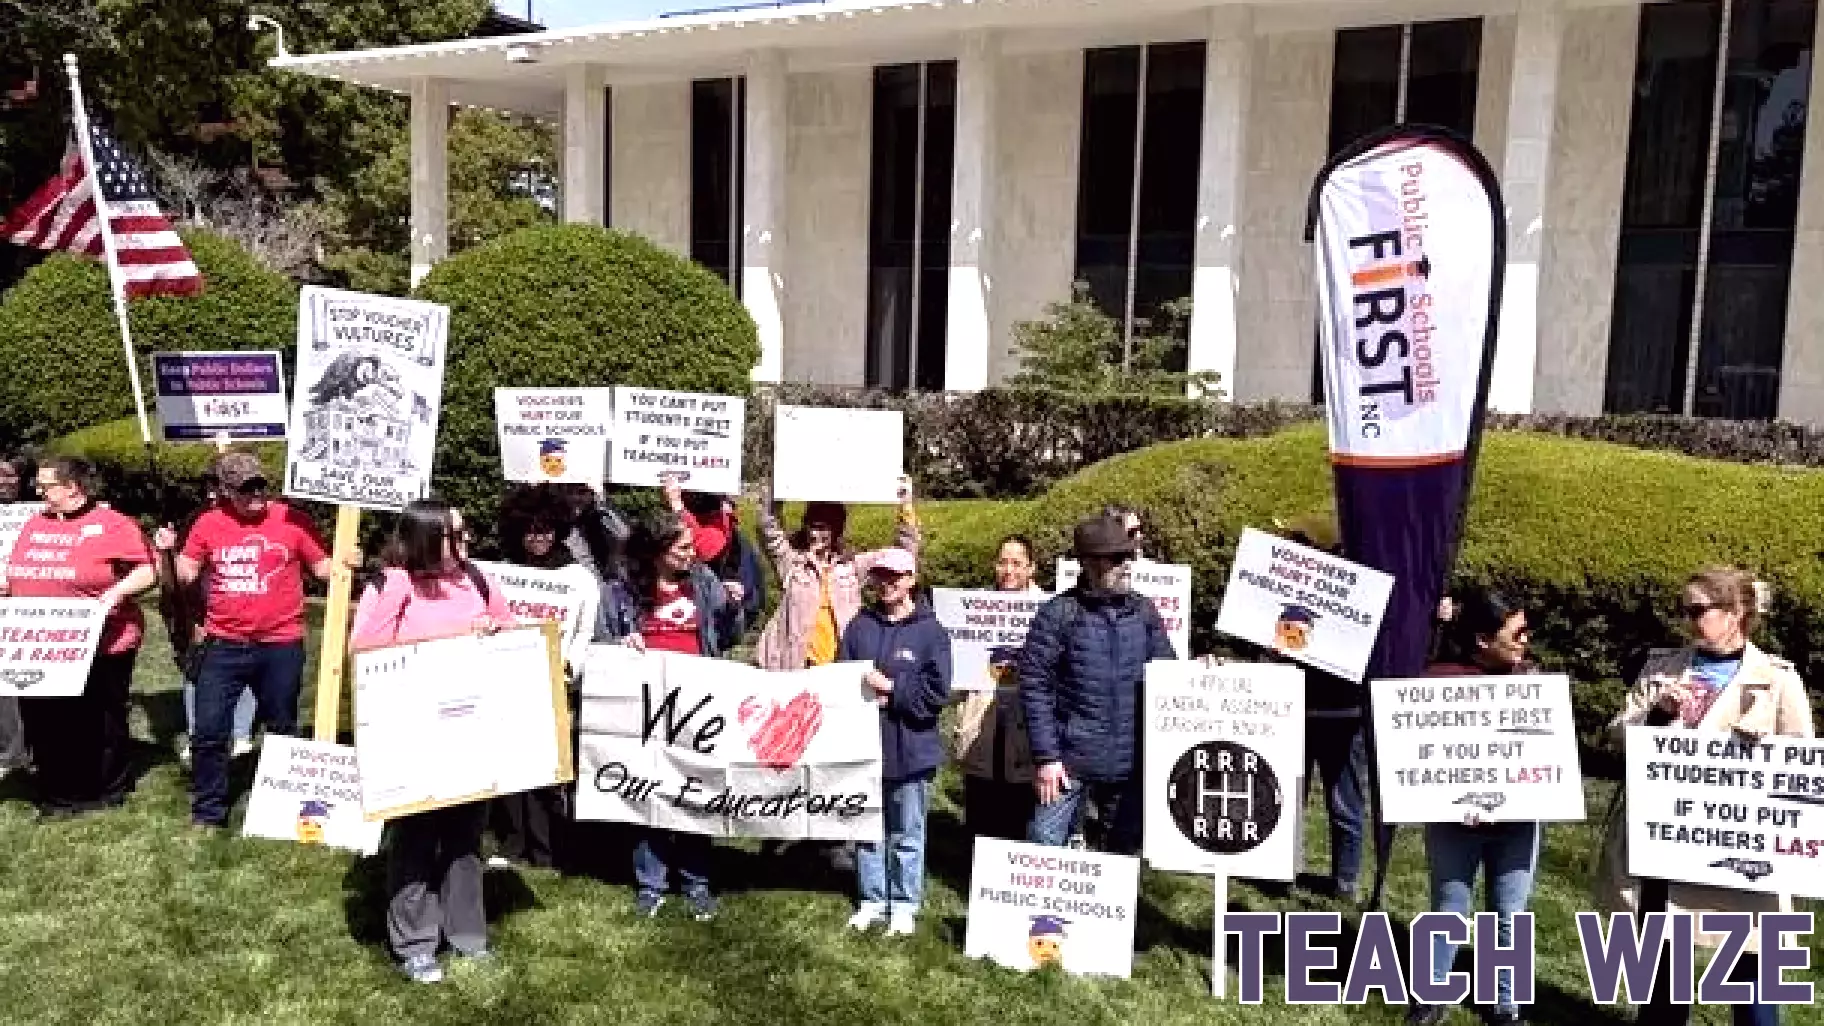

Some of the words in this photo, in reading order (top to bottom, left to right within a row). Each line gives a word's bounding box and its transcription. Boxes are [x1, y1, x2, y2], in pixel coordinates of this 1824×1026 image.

[1400, 160, 1429, 252] Public
[333, 326, 415, 352] VULTURES
[1409, 292, 1441, 404] Schools
[630, 393, 658, 406] YOU
[503, 424, 541, 436] PUBLIC
[545, 424, 606, 437] SCHOOLS
[1361, 402, 1381, 440] NC
[656, 436, 682, 449] YOU
[623, 448, 689, 467] TEACHERS
[1270, 546, 1358, 586] VOUCHERS
[1268, 562, 1313, 585] HURT
[1313, 578, 1350, 600] OUR
[1237, 569, 1294, 598] PUBLIC
[1295, 590, 1372, 627] SCHOOLS
[1009, 614, 1030, 628] OU
[1395, 685, 1435, 704] YOU
[1442, 683, 1498, 703] CAN'T
[1504, 683, 1543, 701] PUT
[642, 682, 726, 754] We
[1391, 709, 1493, 729] STUDENTS
[1498, 707, 1555, 728] FIRST
[1418, 743, 1435, 760] IF
[1442, 743, 1480, 760] YOU
[1487, 740, 1526, 760] PUT
[1652, 734, 1700, 757] YOU
[1394, 767, 1498, 787] TEACHERS
[1505, 764, 1564, 784] LAST!
[1645, 761, 1766, 790] STUDENTS
[594, 761, 664, 803] Our
[674, 776, 870, 820] Educators
[1674, 797, 1697, 817] IF
[1703, 800, 1749, 822] YOU
[1756, 805, 1803, 829] PUT
[1644, 820, 1766, 853] TEACHERS
[1007, 851, 1102, 877] VOUCHERS
[1010, 873, 1055, 889] HURT
[1058, 878, 1096, 897] OUR
[979, 887, 1038, 907] PUBLIC
[1041, 896, 1126, 920] SCHOOLS
